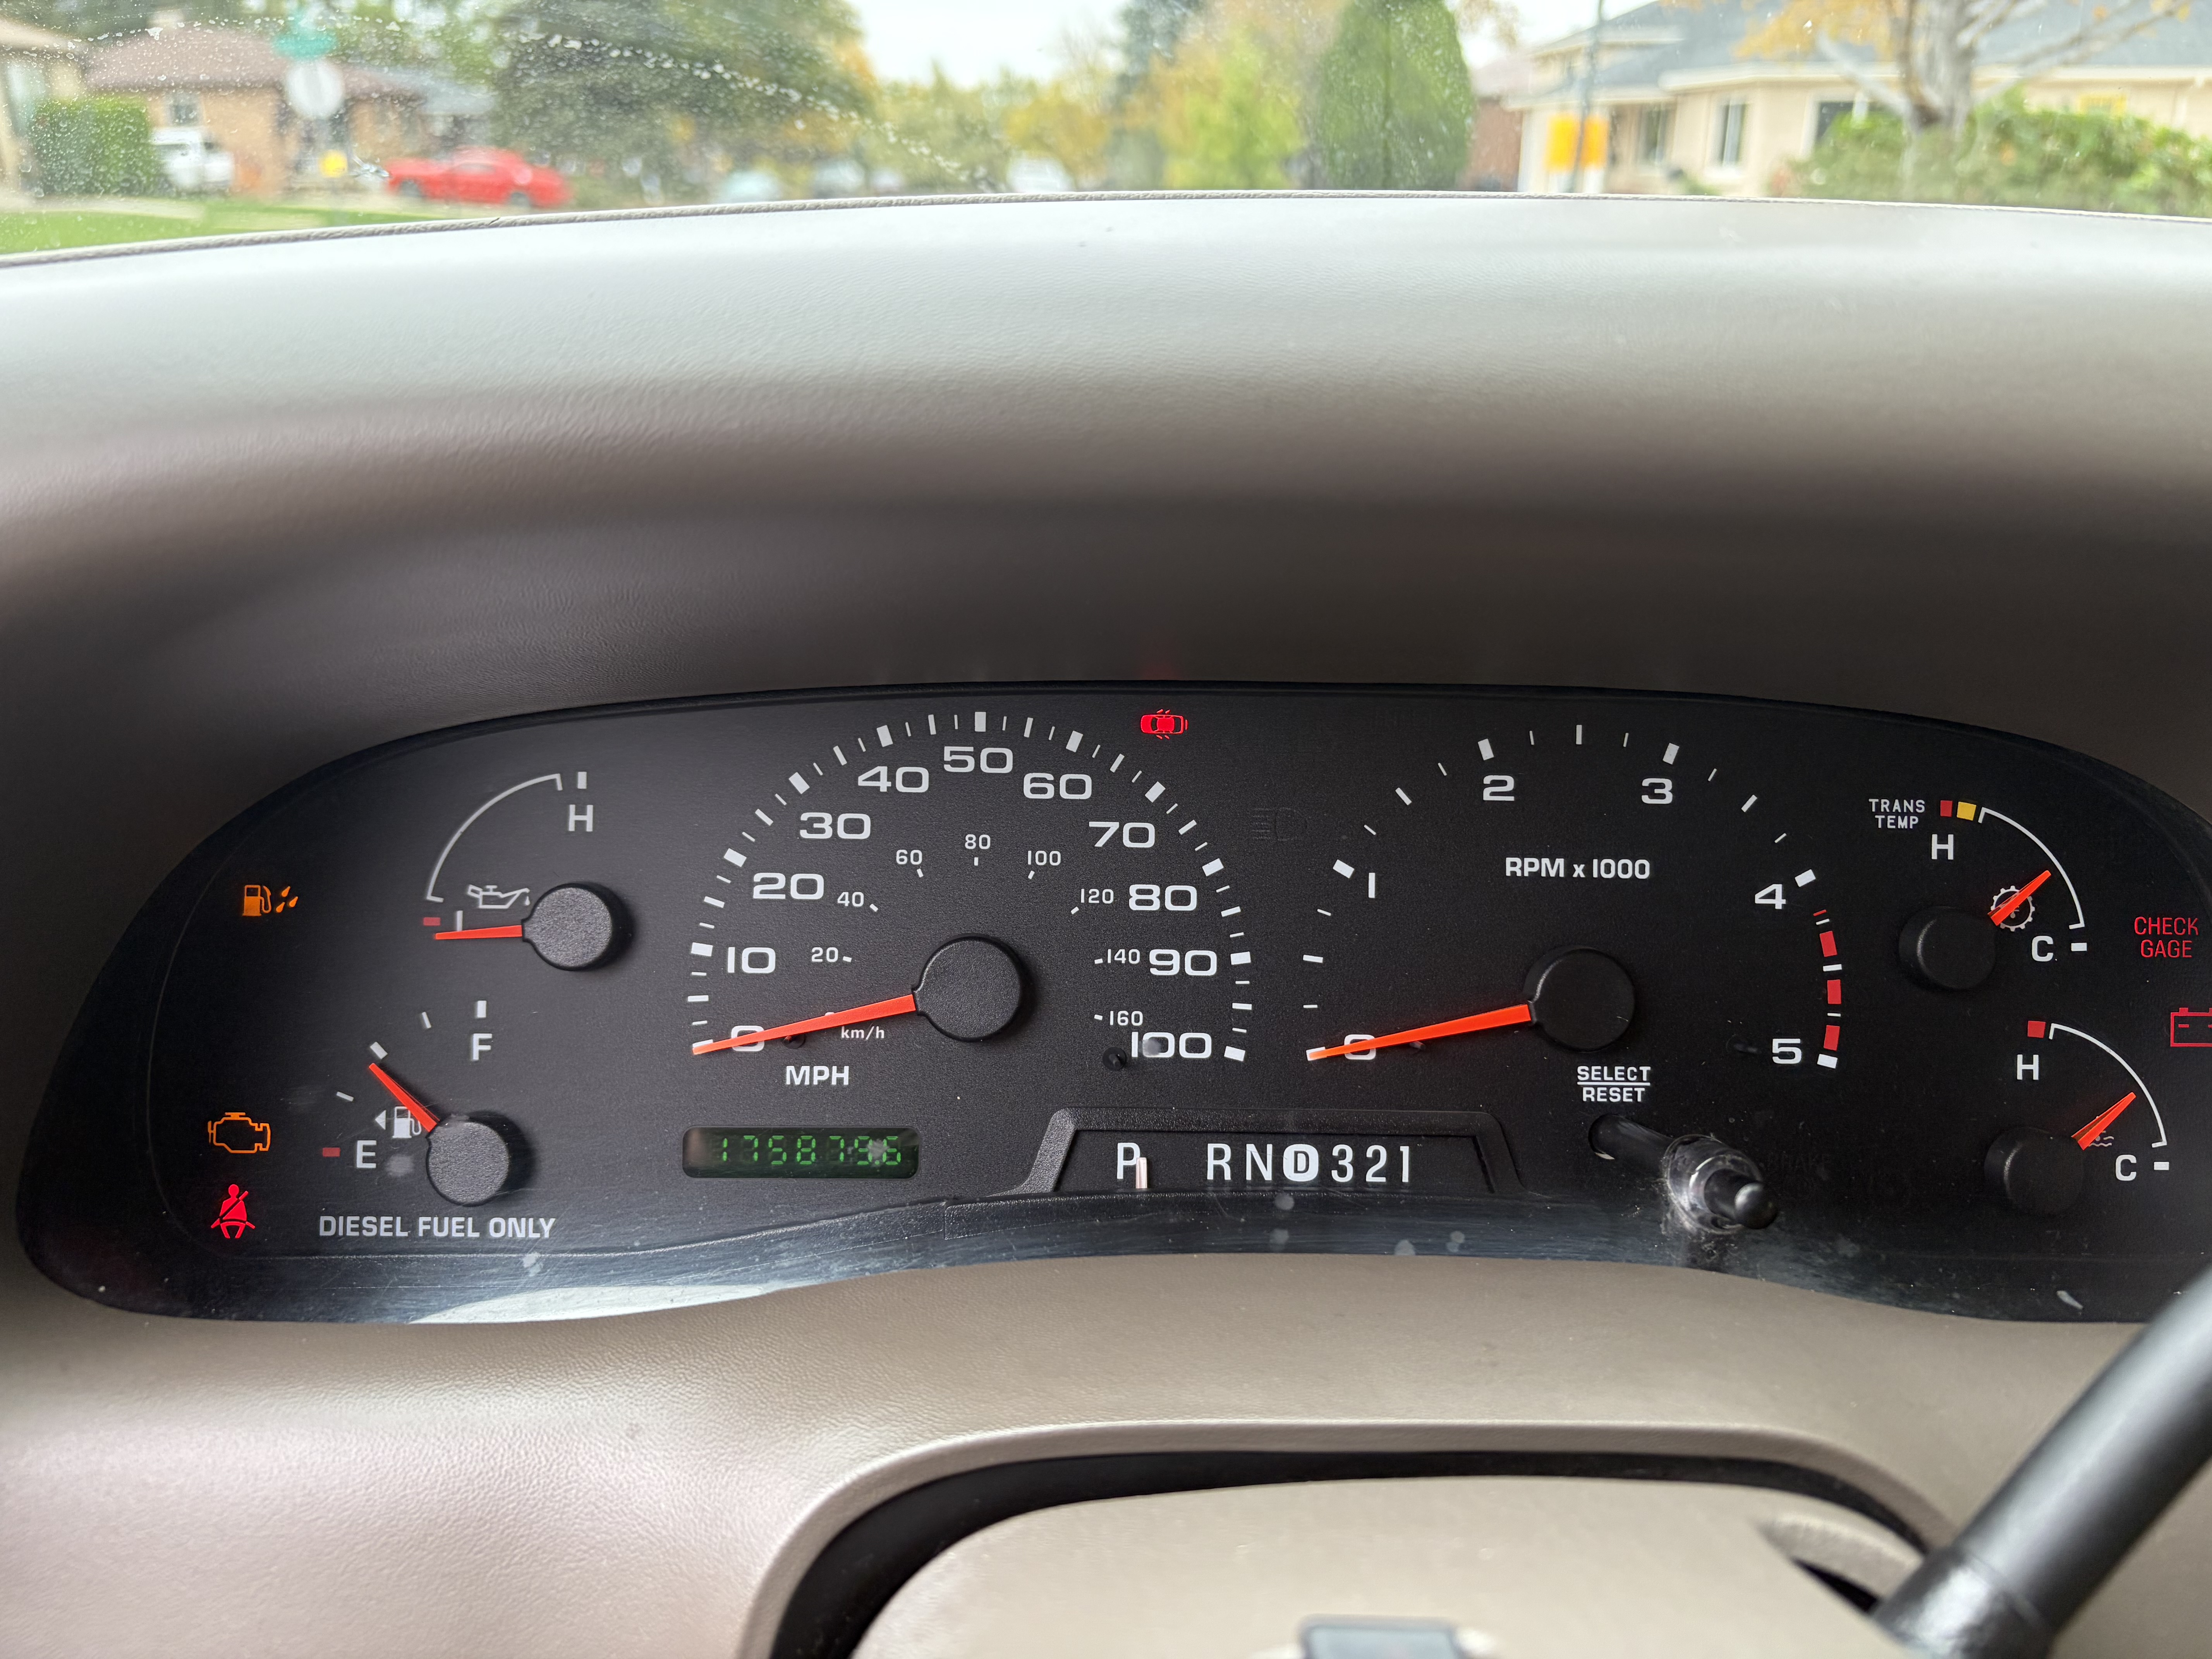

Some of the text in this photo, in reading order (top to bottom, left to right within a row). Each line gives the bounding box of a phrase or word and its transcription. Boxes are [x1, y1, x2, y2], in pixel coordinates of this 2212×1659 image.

[944, 746, 1013, 773] 50
[858, 766, 929, 792] 40
[1024, 773, 1092, 799] 60
[1483, 775, 1514, 801] 2
[1642, 778, 1673, 804] 3
[568, 805, 593, 831] H
[1869, 799, 1925, 812] TRANS
[800, 812, 871, 839] 30
[1089, 822, 1155, 848] 70
[1875, 816, 1918, 828] TEMP
[965, 834, 990, 849] 80
[1932, 834, 1953, 860] H
[896, 850, 922, 865] 60
[1028, 851, 1061, 866] 100
[1506, 857, 1650, 879] RPM x 1000
[753, 873, 824, 899] 20
[1081, 889, 1113, 903] 120
[1129, 884, 1197, 911] 80
[1755, 884, 1786, 909] 4
[838, 892, 864, 907] 40
[2135, 917, 2198, 935] CHECK
[728, 947, 776, 973] 10
[812, 947, 838, 962] 20
[1108, 949, 1140, 964] 140
[2032, 936, 2053, 962] C
[2141, 940, 2192, 957] GAGE
[1149, 949, 1217, 976] 90
[1110, 1011, 1143, 1026] 160
[731, 1025, 765, 1051] 0
[842, 1026, 884, 1040] km/h
[1132, 1032, 1211, 1058] 100
[472, 1034, 492, 1060] F
[1344, 1034, 1376, 1060] 0
[1772, 1039, 1802, 1064] 5
[786, 1066, 849, 1085] MPH
[1577, 1066, 1650, 1081] SELECT
[2017, 1054, 2039, 1080] H
[1583, 1087, 1645, 1102] RESET
[356, 1140, 376, 1168] E
[1117, 1143, 1140, 1180] P
[1207, 1144, 1231, 1180] R
[1246, 1144, 1272, 1180] N
[1332, 1144, 1353, 1182] 3
[1366, 1145, 1386, 1182] 2
[1400, 1146, 1409, 1182] 1
[2116, 1155, 2136, 1181] C
[320, 1216, 556, 1239] DIESEL FUEL ONLY
